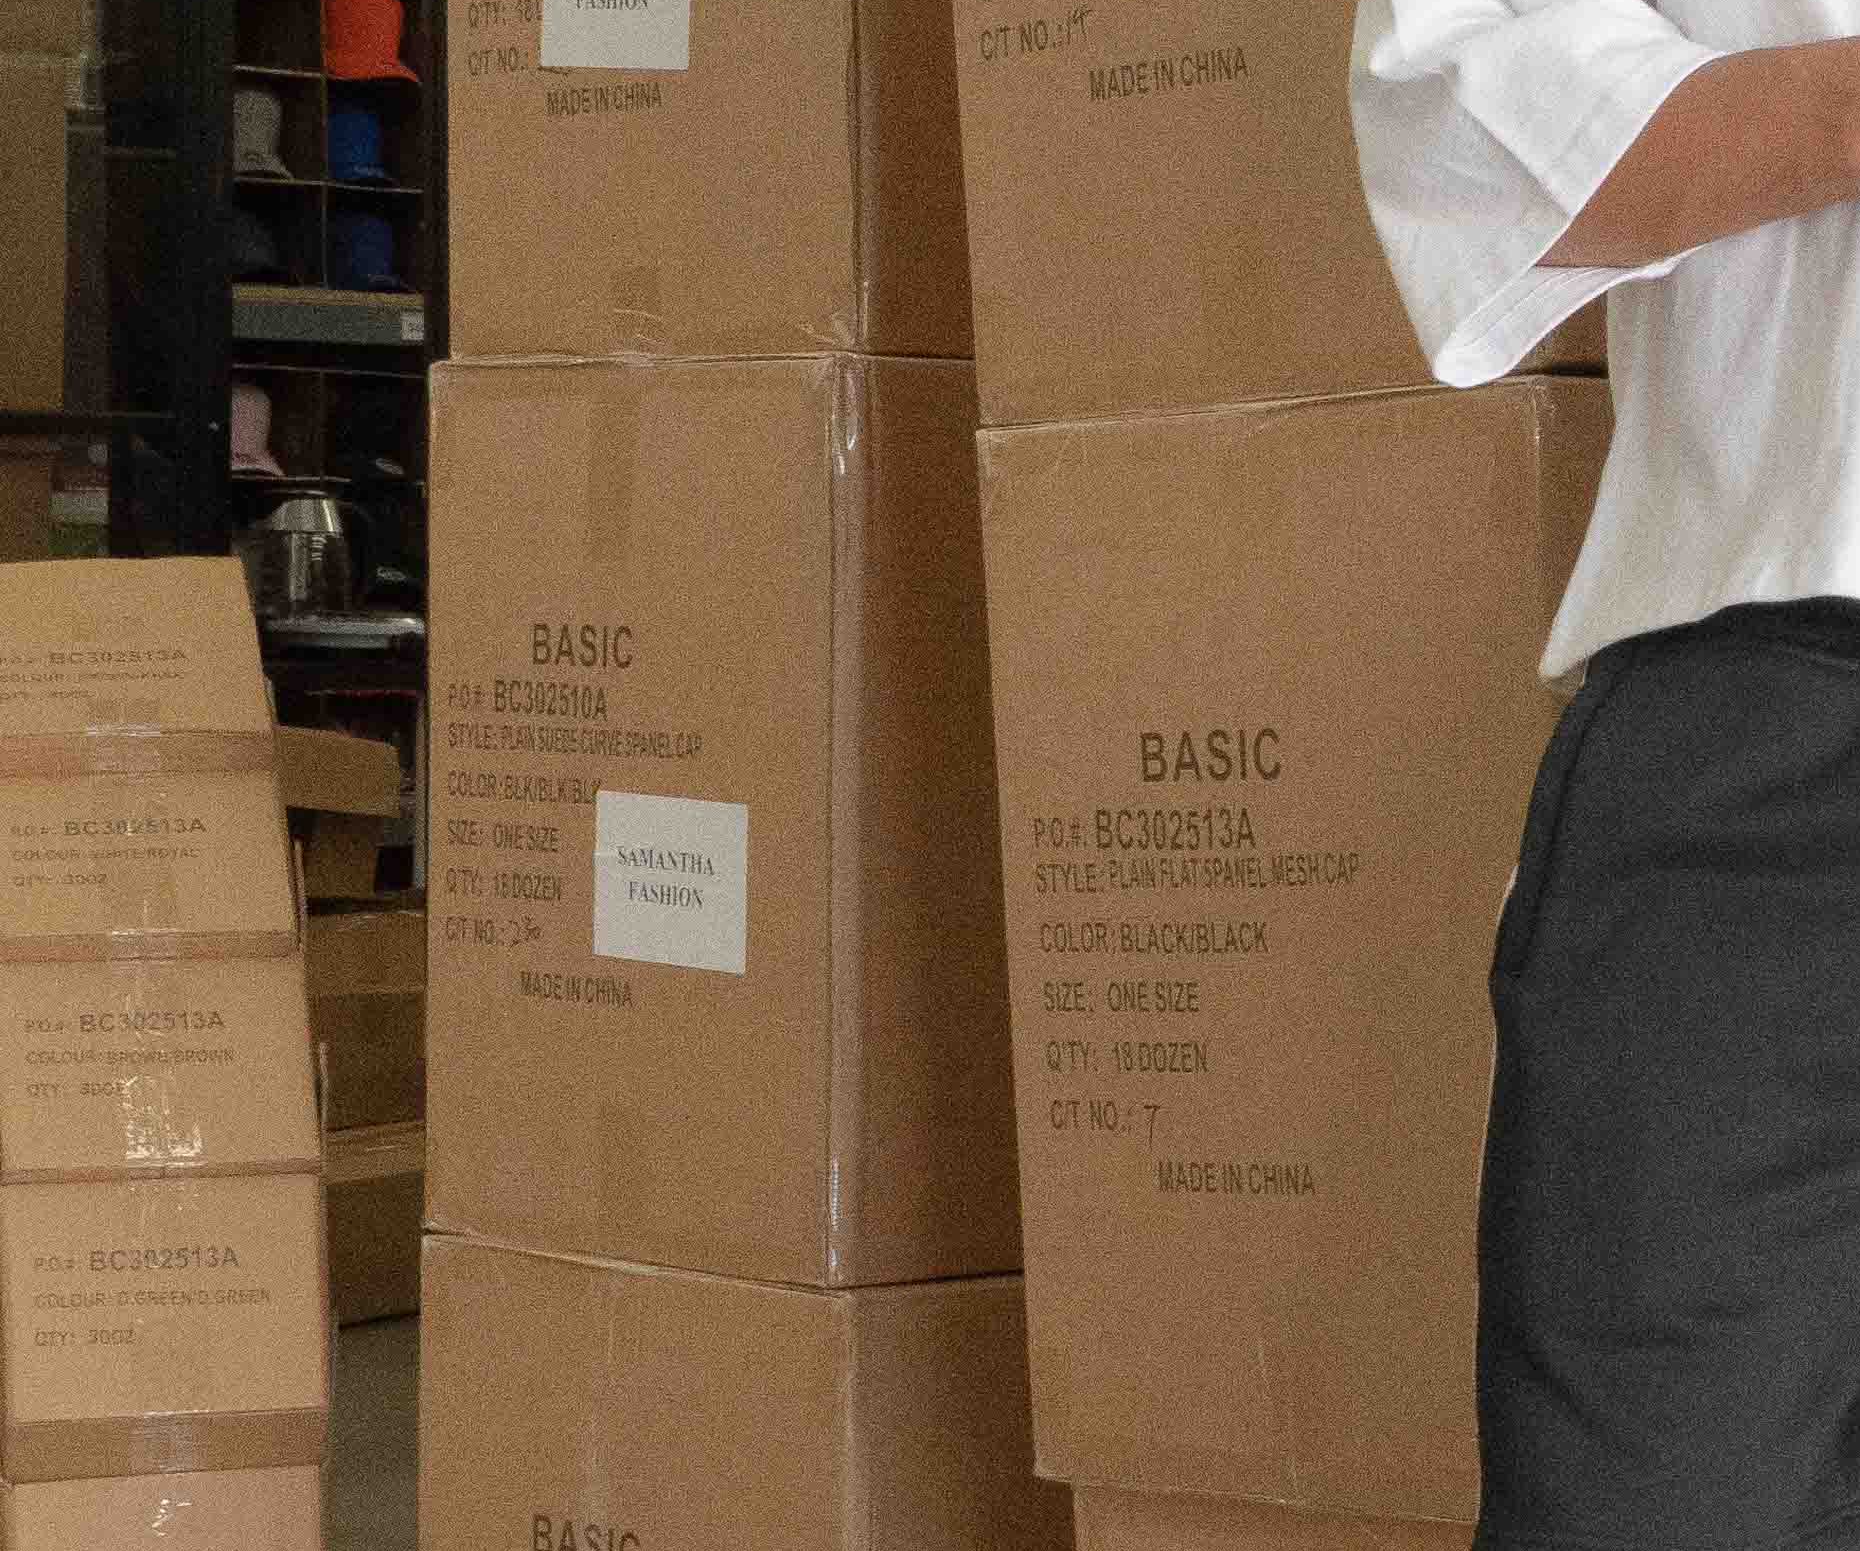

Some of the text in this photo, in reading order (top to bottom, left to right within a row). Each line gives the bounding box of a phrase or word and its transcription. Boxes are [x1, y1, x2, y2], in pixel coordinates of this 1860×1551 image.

[1088, 46, 1249, 102] MADE IN CHINA
[531, 622, 635, 669] BASIC
[493, 679, 609, 721] BC302510A
[1139, 727, 1282, 784] BASIC
[1095, 807, 1257, 851] BC302513A
[616, 845, 716, 877] SAMANTHA
[1036, 862, 1106, 894] STYLE:
[1109, 859, 1156, 889] PLAIN
[1159, 857, 1199, 888] FLAT
[1271, 854, 1319, 887] MESH
[1324, 852, 1360, 886] CAP
[627, 883, 704, 910] FASHION
[1039, 921, 1270, 955] COLOR: BLACK/BLACK
[1043, 981, 1200, 1014] SIZE: ONE SIZE
[79, 1010, 225, 1034] BC302513A
[1113, 1042, 1135, 1074] 18
[1138, 1042, 1208, 1074] DOZEN
[1157, 1160, 1317, 1196] MADE IN CHINA
[89, 1246, 240, 1272] BC302513A
